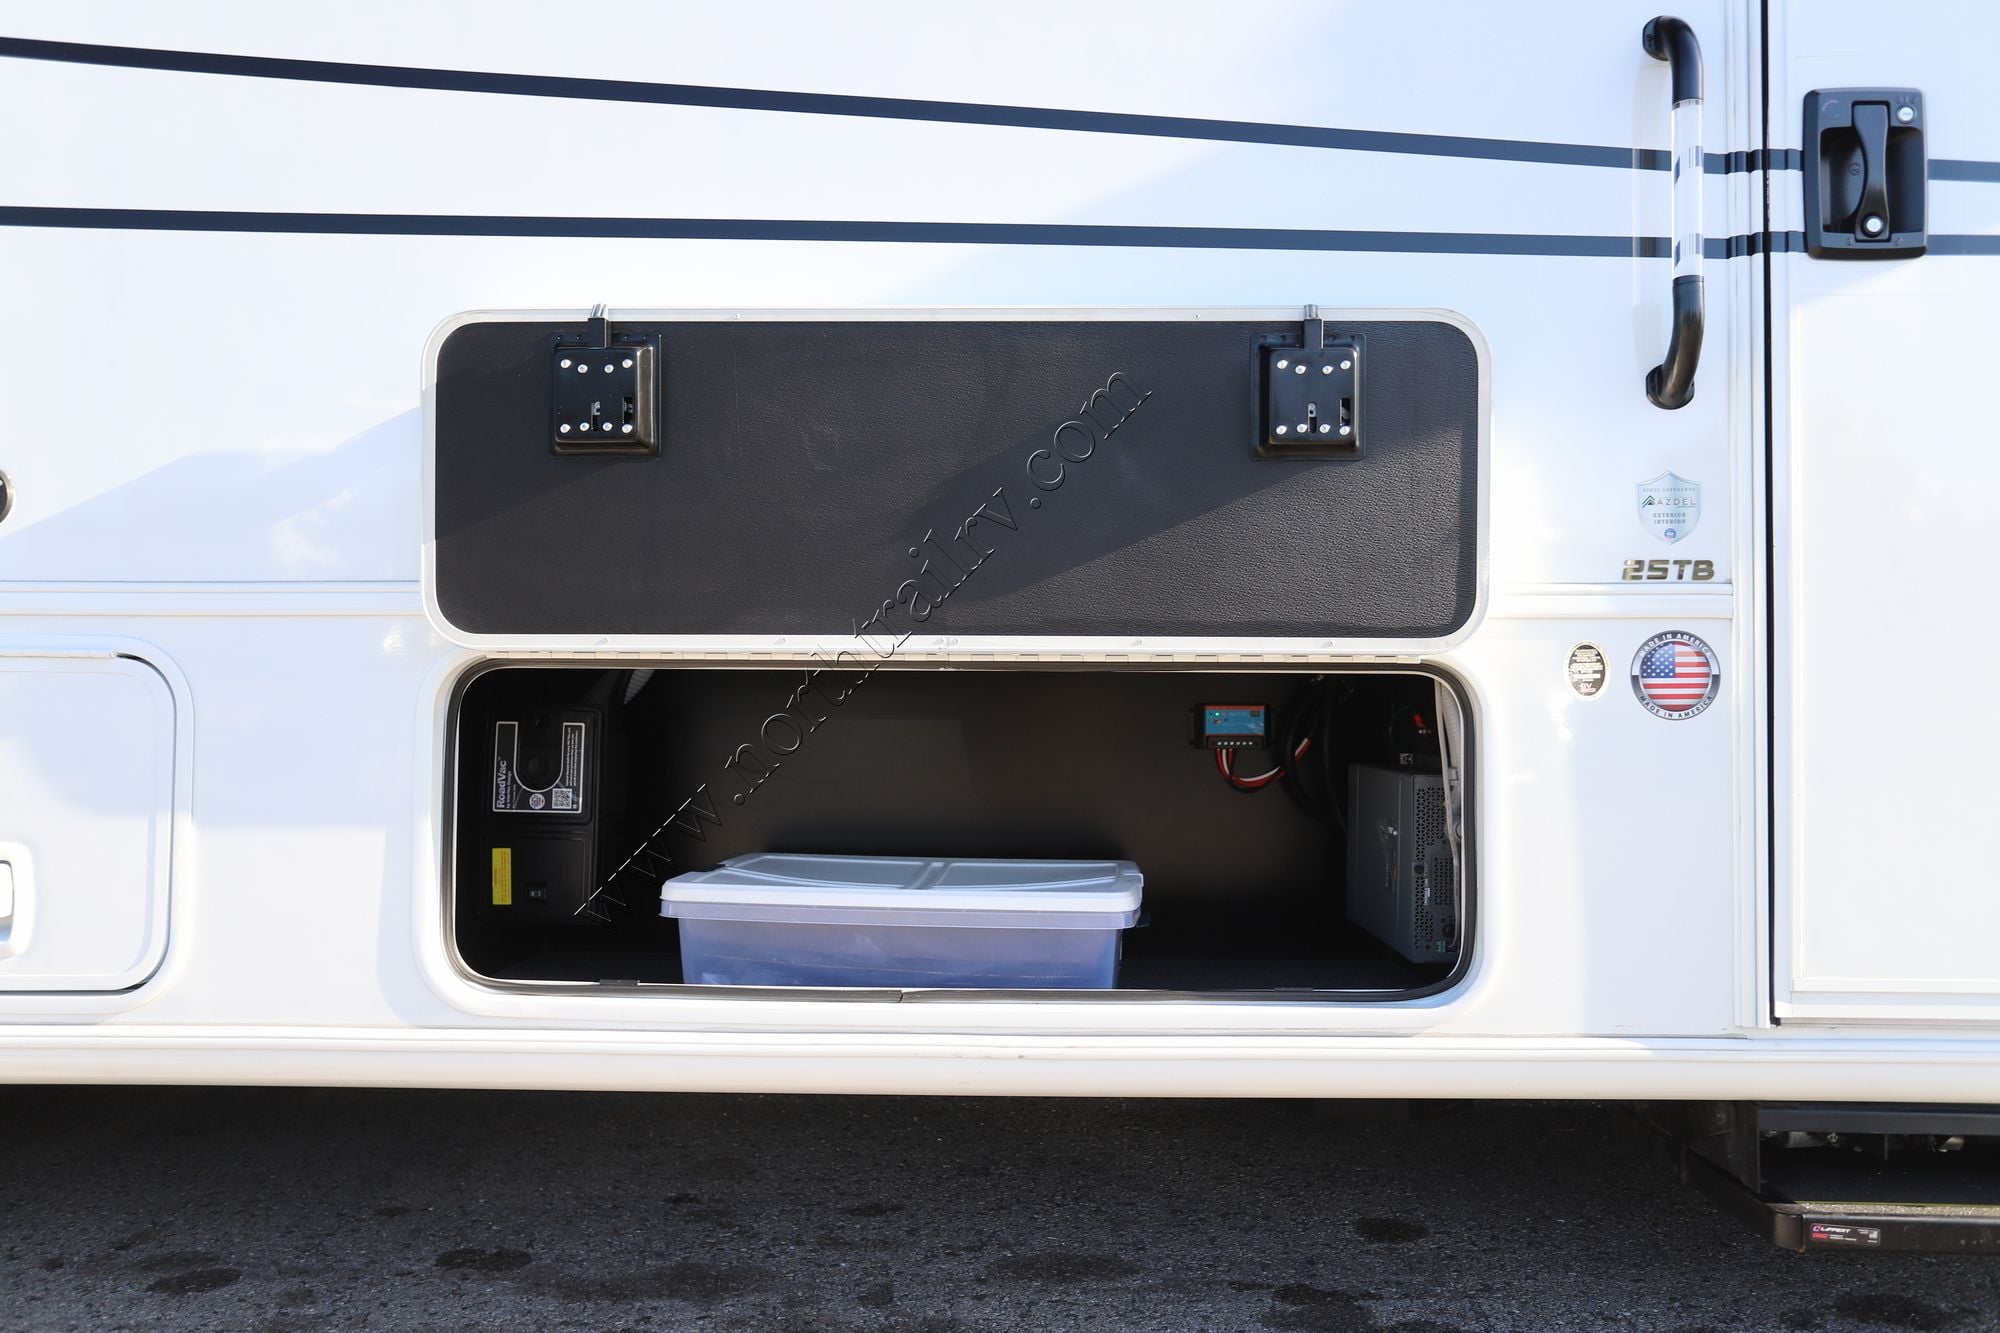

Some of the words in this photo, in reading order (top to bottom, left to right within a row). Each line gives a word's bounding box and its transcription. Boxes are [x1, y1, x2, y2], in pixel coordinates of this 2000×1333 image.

[1657, 498, 1697, 506] AZDEL
[1622, 559, 1715, 581] 25TB
[1639, 637, 1661, 659] MADE
[1662, 633, 1673, 641] IN
[1676, 633, 1713, 659] AMERICA
[1639, 694, 1661, 716] MADE
[1663, 711, 1674, 719] IN
[1677, 694, 1714, 719] AMERICA
